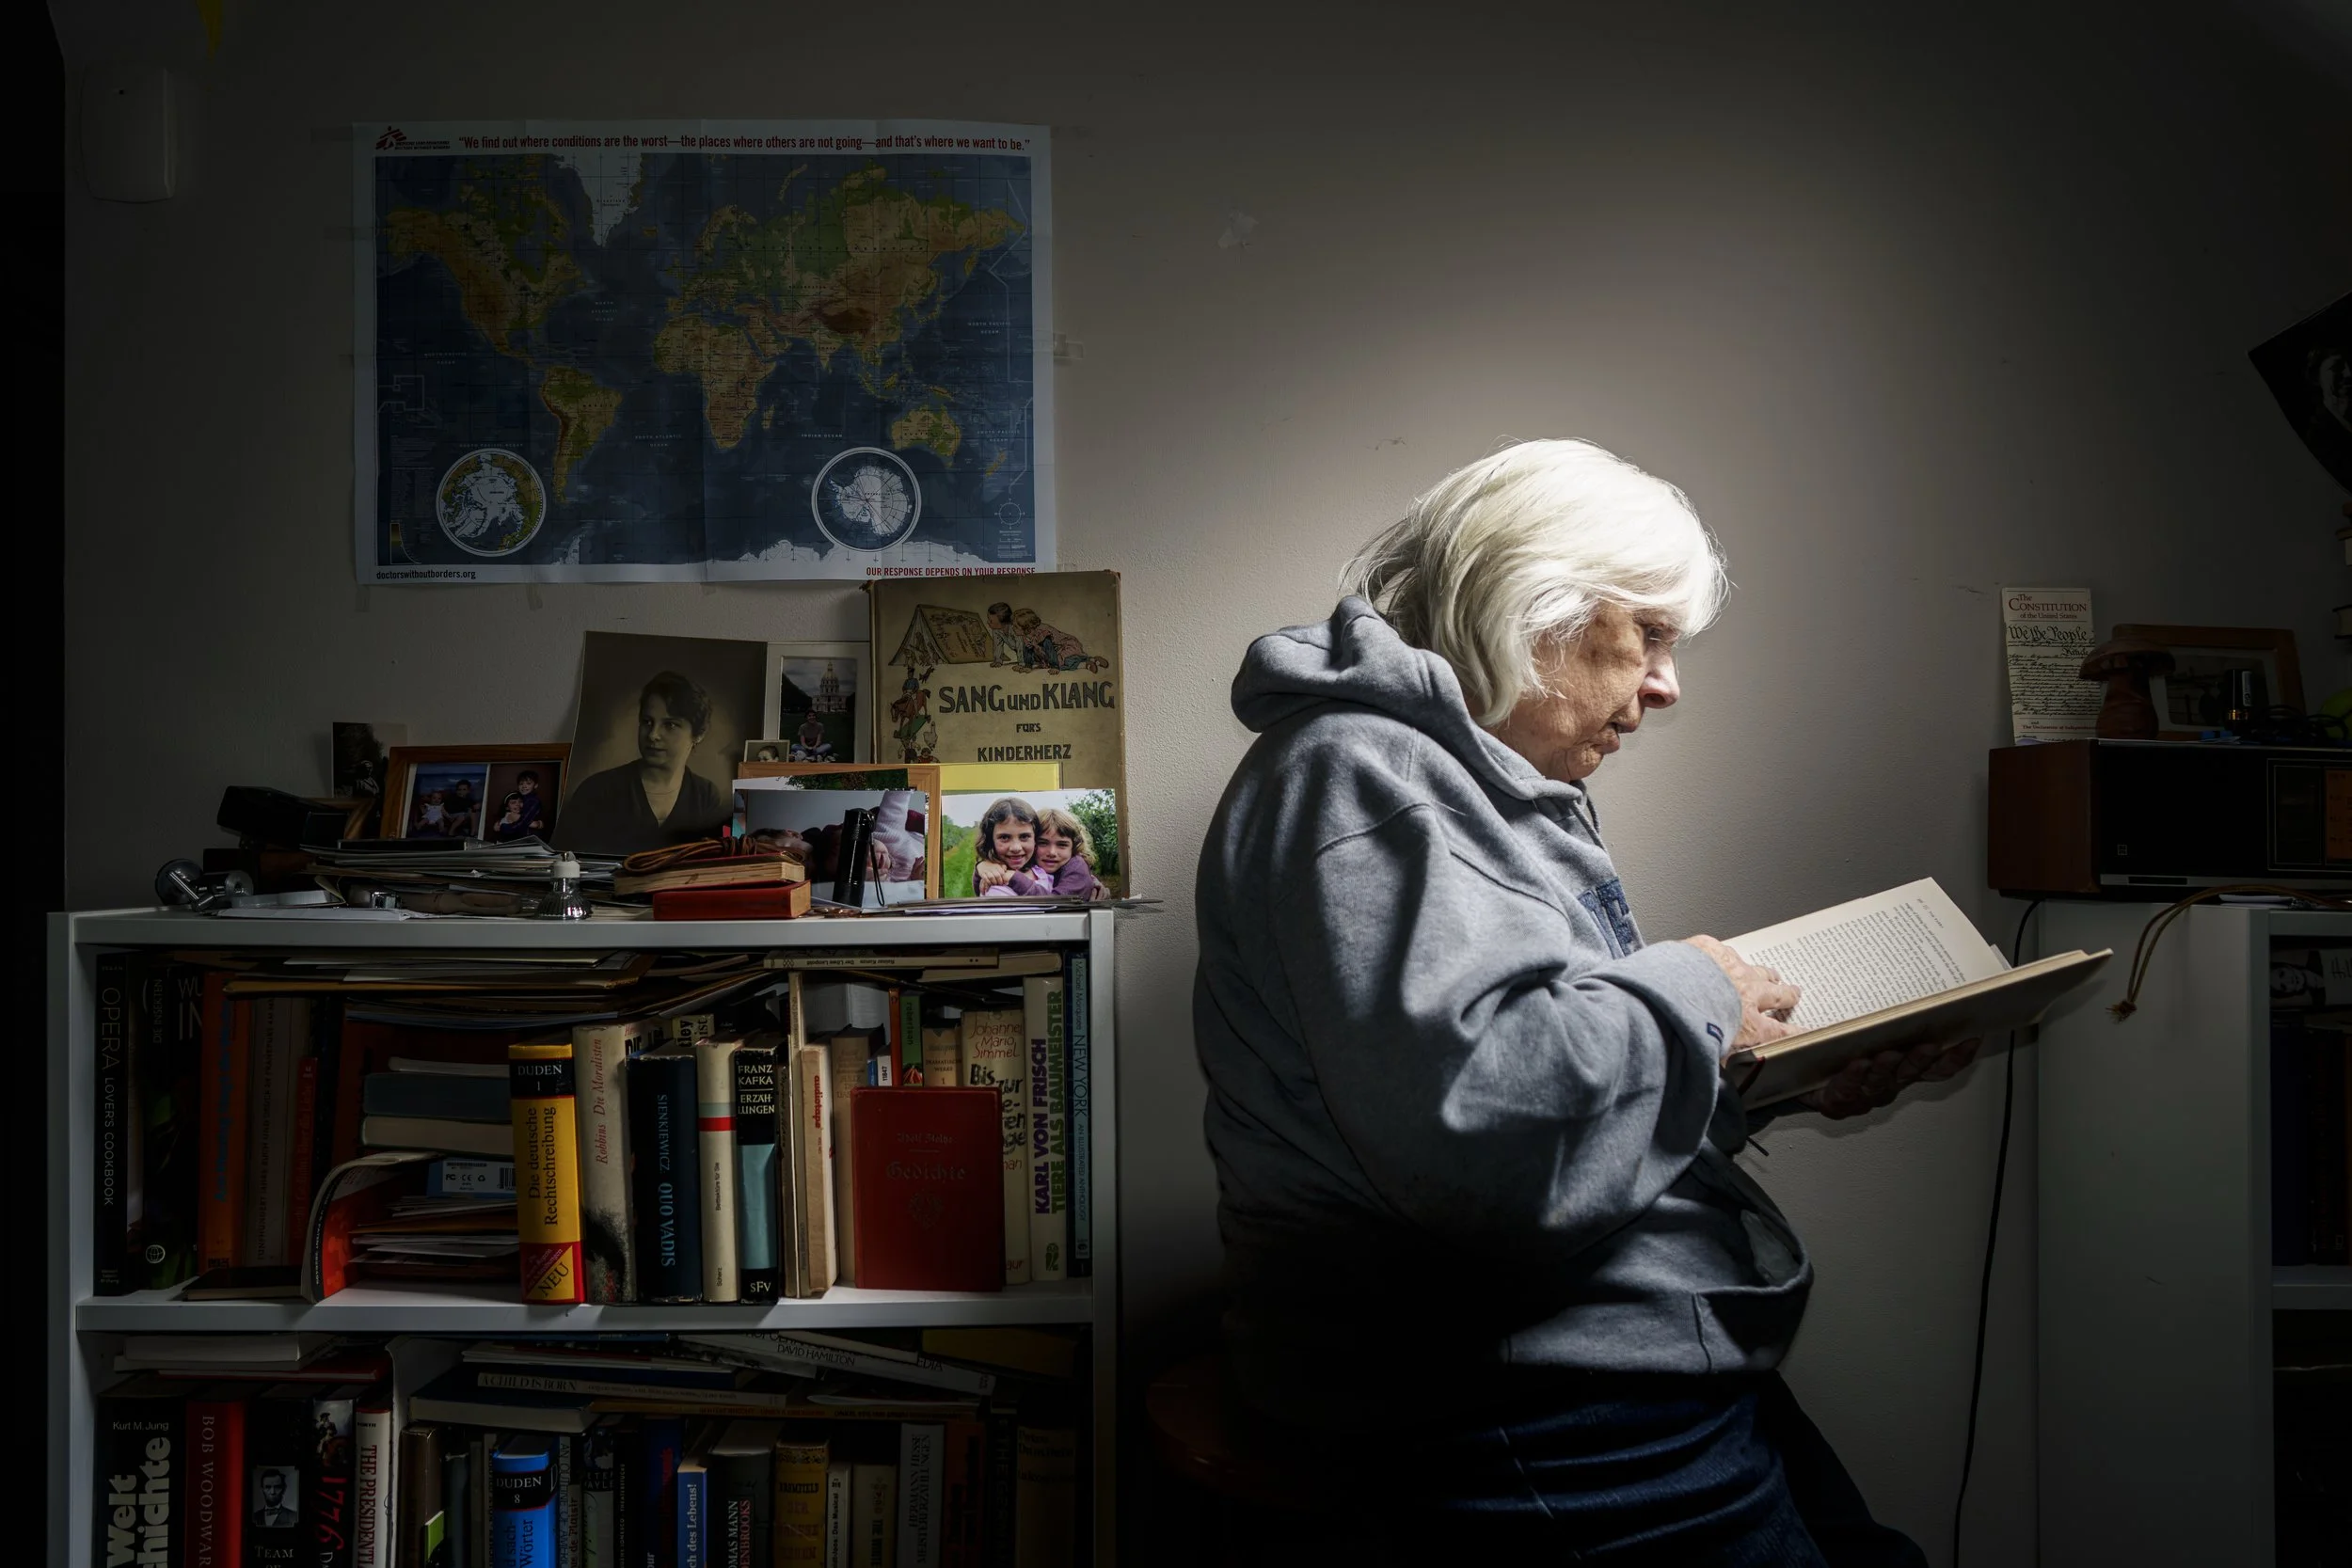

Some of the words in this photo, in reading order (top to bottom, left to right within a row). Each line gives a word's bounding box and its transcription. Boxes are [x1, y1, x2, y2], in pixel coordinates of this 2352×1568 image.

[481, 135, 500, 149] find
[502, 136, 517, 148] out
[520, 135, 548, 148] where
[552, 135, 601, 148] conditions
[605, 137, 620, 147] are
[623, 135, 639, 147] the
[699, 135, 730, 149] places
[734, 135, 763, 148] where
[766, 135, 796, 149] others
[799, 138, 815, 148] are
[818, 136, 833, 148] not
[924, 135, 954, 149] where
[956, 138, 970, 149] we
[973, 137, 995, 149] want
[998, 137, 1008, 149] to
[376, 570, 476, 579] doctorswithoutborders.org
[866, 567, 882, 576] OUR
[883, 567, 923, 576] RESPONSE
[925, 567, 960, 576] DEPENDS
[2008, 597, 2088, 611] CONSTITUTION
[2046, 626, 2087, 644] People
[939, 685, 1005, 714] SANG
[1007, 693, 1041, 710] UND
[1042, 681, 1115, 710] KLANG
[977, 743, 1072, 763] KINDERHERZ
[1074, 961, 1084, 990] Michael
[152, 978, 163, 1025] INSEKTEN
[102, 987, 121, 1070] OPERA
[152, 1026, 163, 1045] DIE
[980, 1037, 1015, 1049] Mario
[590, 1038, 606, 1094] Moralisten
[972, 1044, 1019, 1059] Simmel
[1047, 990, 1064, 1116] BAUMEISTER
[1073, 1034, 1087, 1072] NEW
[517, 1064, 563, 1076] DUDEN
[738, 1064, 773, 1074] FRANZ
[738, 1076, 773, 1085] KAFKA
[969, 1063, 995, 1086] Bis
[1031, 1038, 1049, 1107] FRISCH
[103, 1076, 116, 1128] LOVER'S
[536, 1081, 541, 1092] 1
[813, 1075, 823, 1129] audiotape
[1074, 1077, 1088, 1117] YORK
[593, 1096, 606, 1116] Die
[738, 1104, 775, 1115] LUNGEN
[525, 1106, 539, 1169] deutsche
[596, 1123, 609, 1165] Robbins
[1033, 1114, 1049, 1158] VON
[1049, 1118, 1065, 1155] ALS
[1078, 1123, 1086, 1134] AN
[103, 1132, 115, 1206] COOKBOOK
[541, 1106, 558, 1226] Rechtschreibung
[885, 1161, 966, 1184] Gedichte
[529, 1174, 541, 1199] Die
[659, 1182, 674, 1216] QUO
[1035, 1162, 1050, 1214] KARL
[1051, 1160, 1066, 1214] TIERE
[1078, 1178, 1087, 1221] ANTHOLOGY
[660, 1218, 676, 1268] VADIS
[537, 1261, 569, 1297] NEU
[776, 1343, 804, 1357] DAVID
[805, 1348, 855, 1367] HAMILTON
[482, 1373, 489, 1386] A
[491, 1374, 529, 1389] CHILD
[531, 1377, 542, 1391] IS
[544, 1378, 577, 1392] BORN
[113, 1421, 131, 1430] Kurt
[133, 1421, 144, 1430] M.
[145, 1421, 169, 1432] Jung
[200, 1416, 215, 1453] BOB
[360, 1445, 377, 1476] THE
[496, 1476, 542, 1488] DUDEN
[315, 1476, 348, 1550] 1776
[514, 1493, 521, 1504] 8
[687, 1483, 697, 1528] Lebens!
[908, 1470, 919, 1528] HERMANN
[106, 1474, 137, 1568] Welt
[569, 1497, 579, 1537] Plaisir
[728, 1500, 739, 1536] MANN
[254, 1545, 294, 1559] TEAM
[569, 1539, 579, 1553] de
[687, 1529, 697, 1552] des
